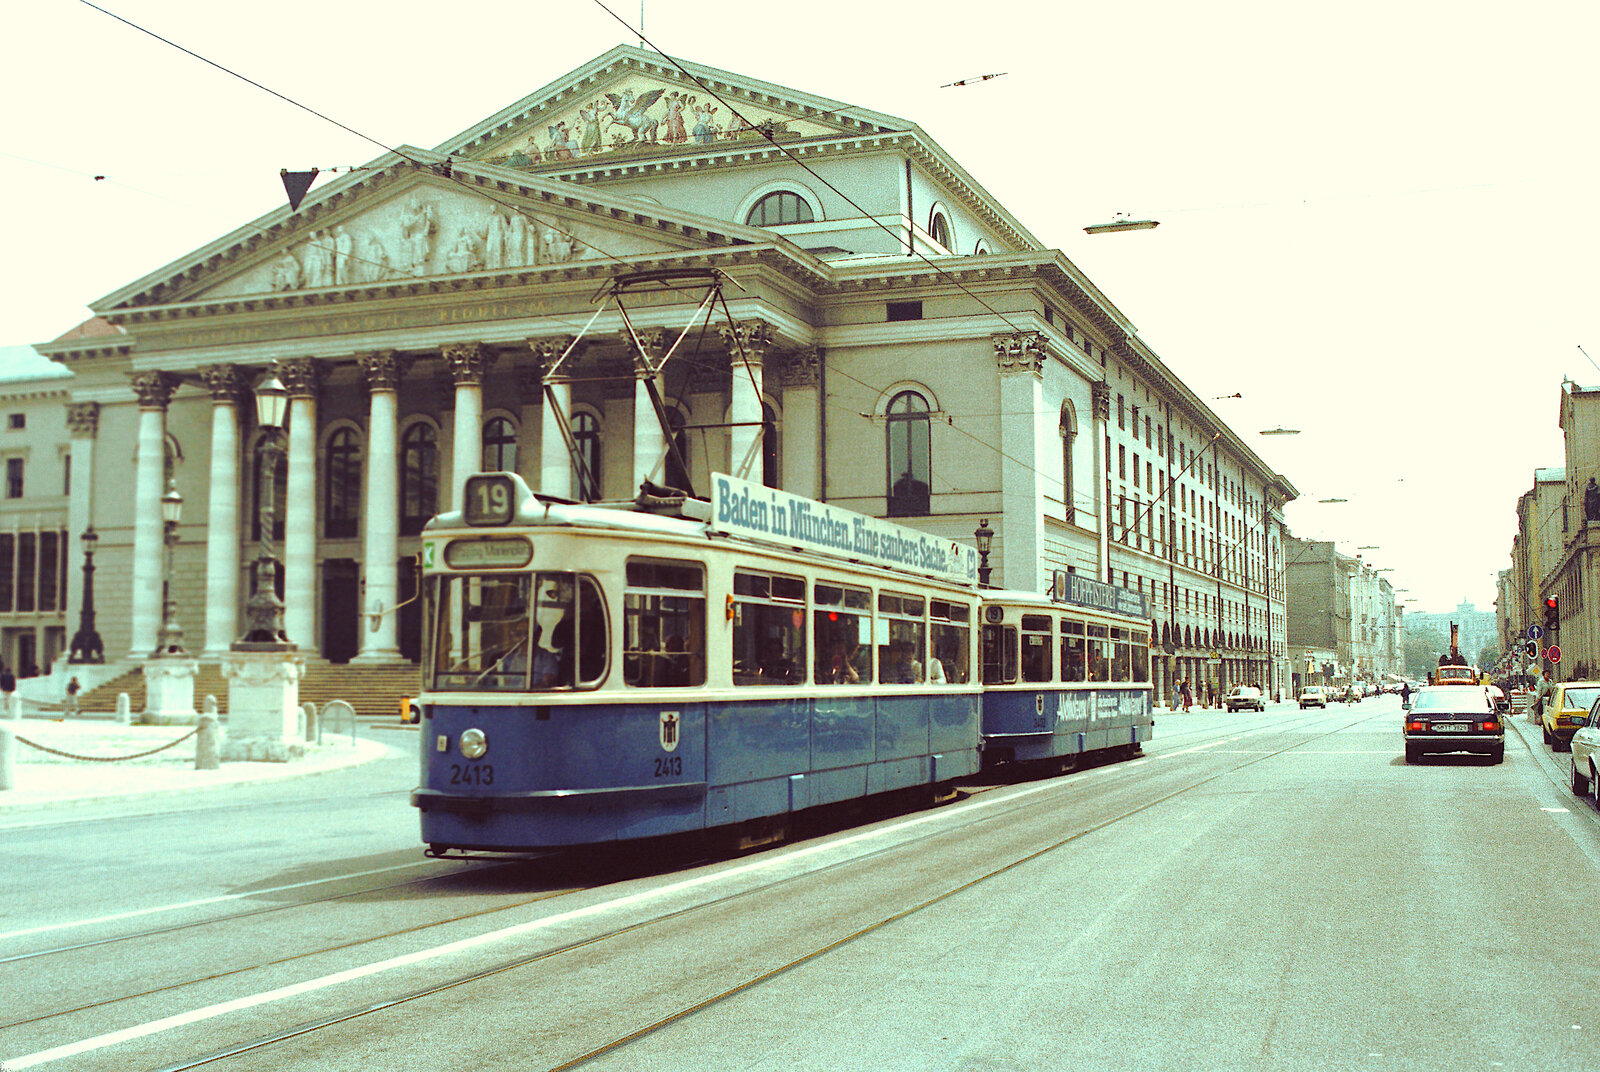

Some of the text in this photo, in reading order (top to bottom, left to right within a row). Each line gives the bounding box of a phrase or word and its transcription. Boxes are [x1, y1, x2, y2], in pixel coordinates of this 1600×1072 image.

[478, 484, 508, 515] 19
[718, 478, 768, 532] Baden
[771, 493, 788, 536] in
[789, 498, 852, 548] München.
[853, 518, 878, 557] Eine
[880, 529, 918, 565] saubere
[919, 537, 948, 572] Sache.
[451, 764, 494, 786] 2413
[654, 756, 682, 778] 2413
